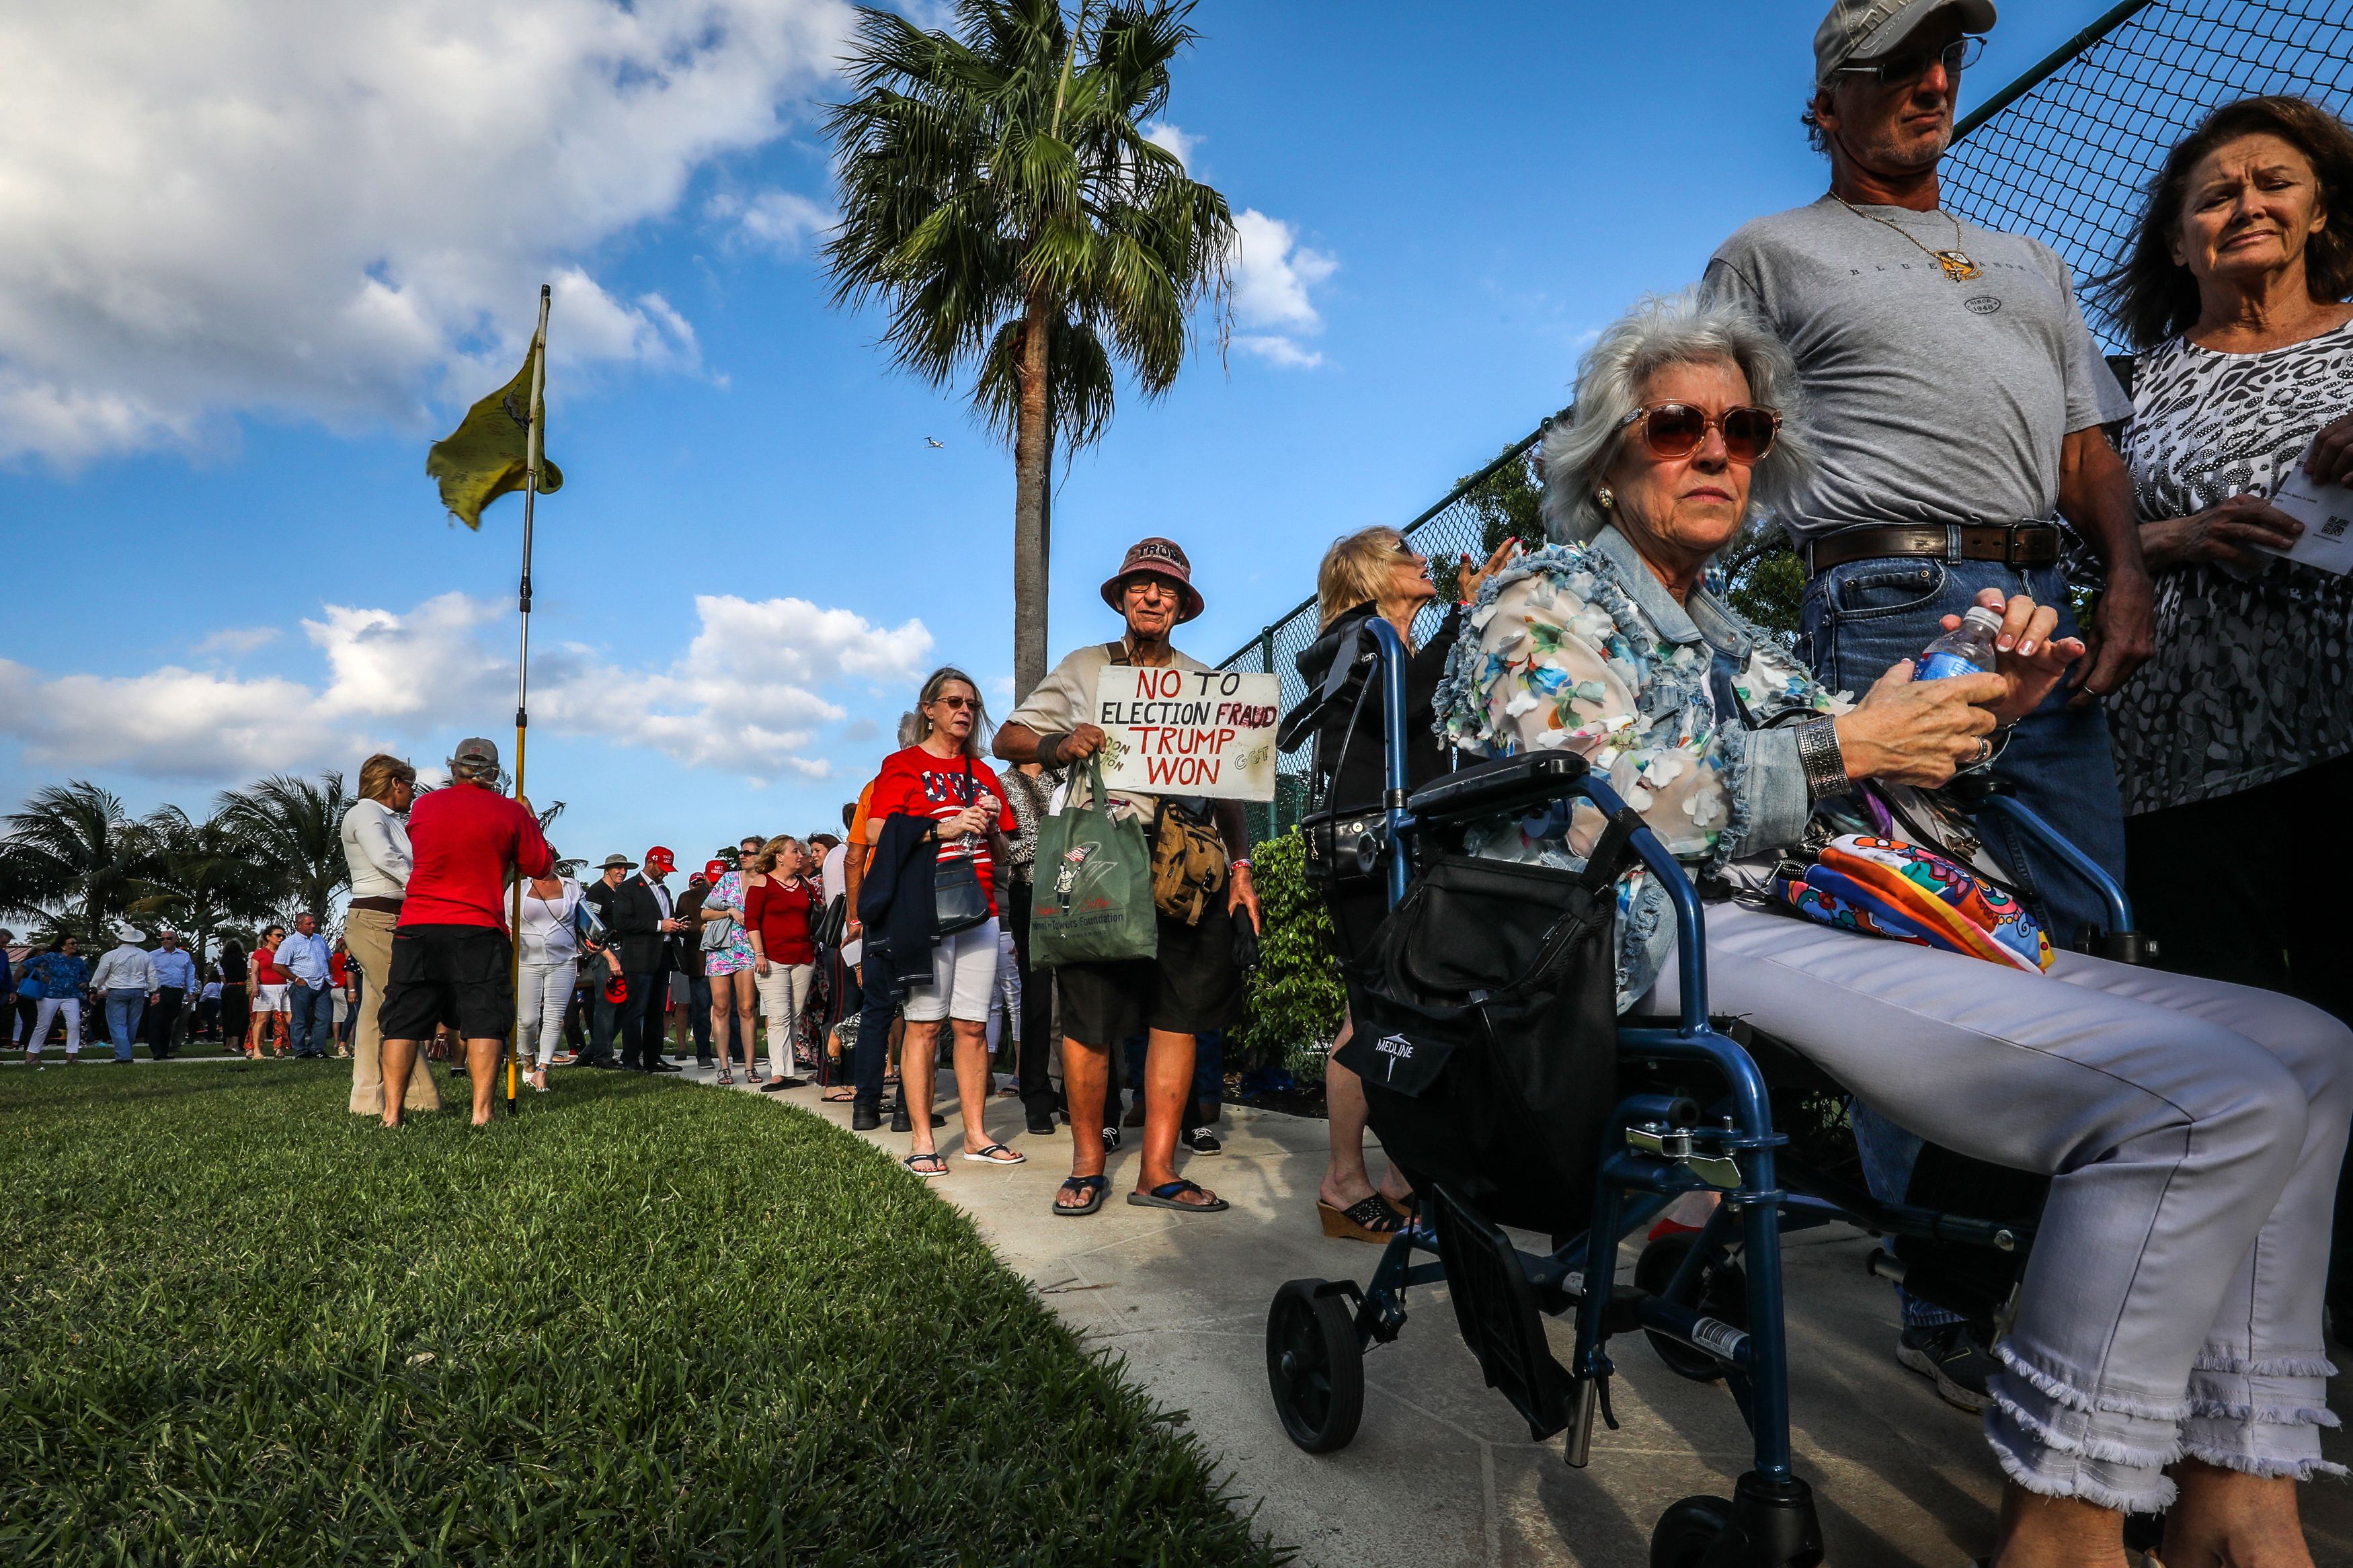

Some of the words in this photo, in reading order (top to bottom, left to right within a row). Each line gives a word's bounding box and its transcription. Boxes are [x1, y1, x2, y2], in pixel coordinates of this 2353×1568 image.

[1851, 263, 1938, 276] BLUE
[1969, 298, 1991, 306] SINCE
[1135, 669, 1181, 700] NO
[1193, 672, 1240, 696] TO
[1101, 702, 1211, 725] ELECTION
[1215, 702, 1277, 729] FRAUD
[1128, 727, 1235, 755] TRUMP
[1147, 757, 1220, 785] WON
[1051, 918, 1078, 931] Towers
[1079, 912, 1123, 927] Foundation
[1375, 1038, 1414, 1058] MEDLINE
